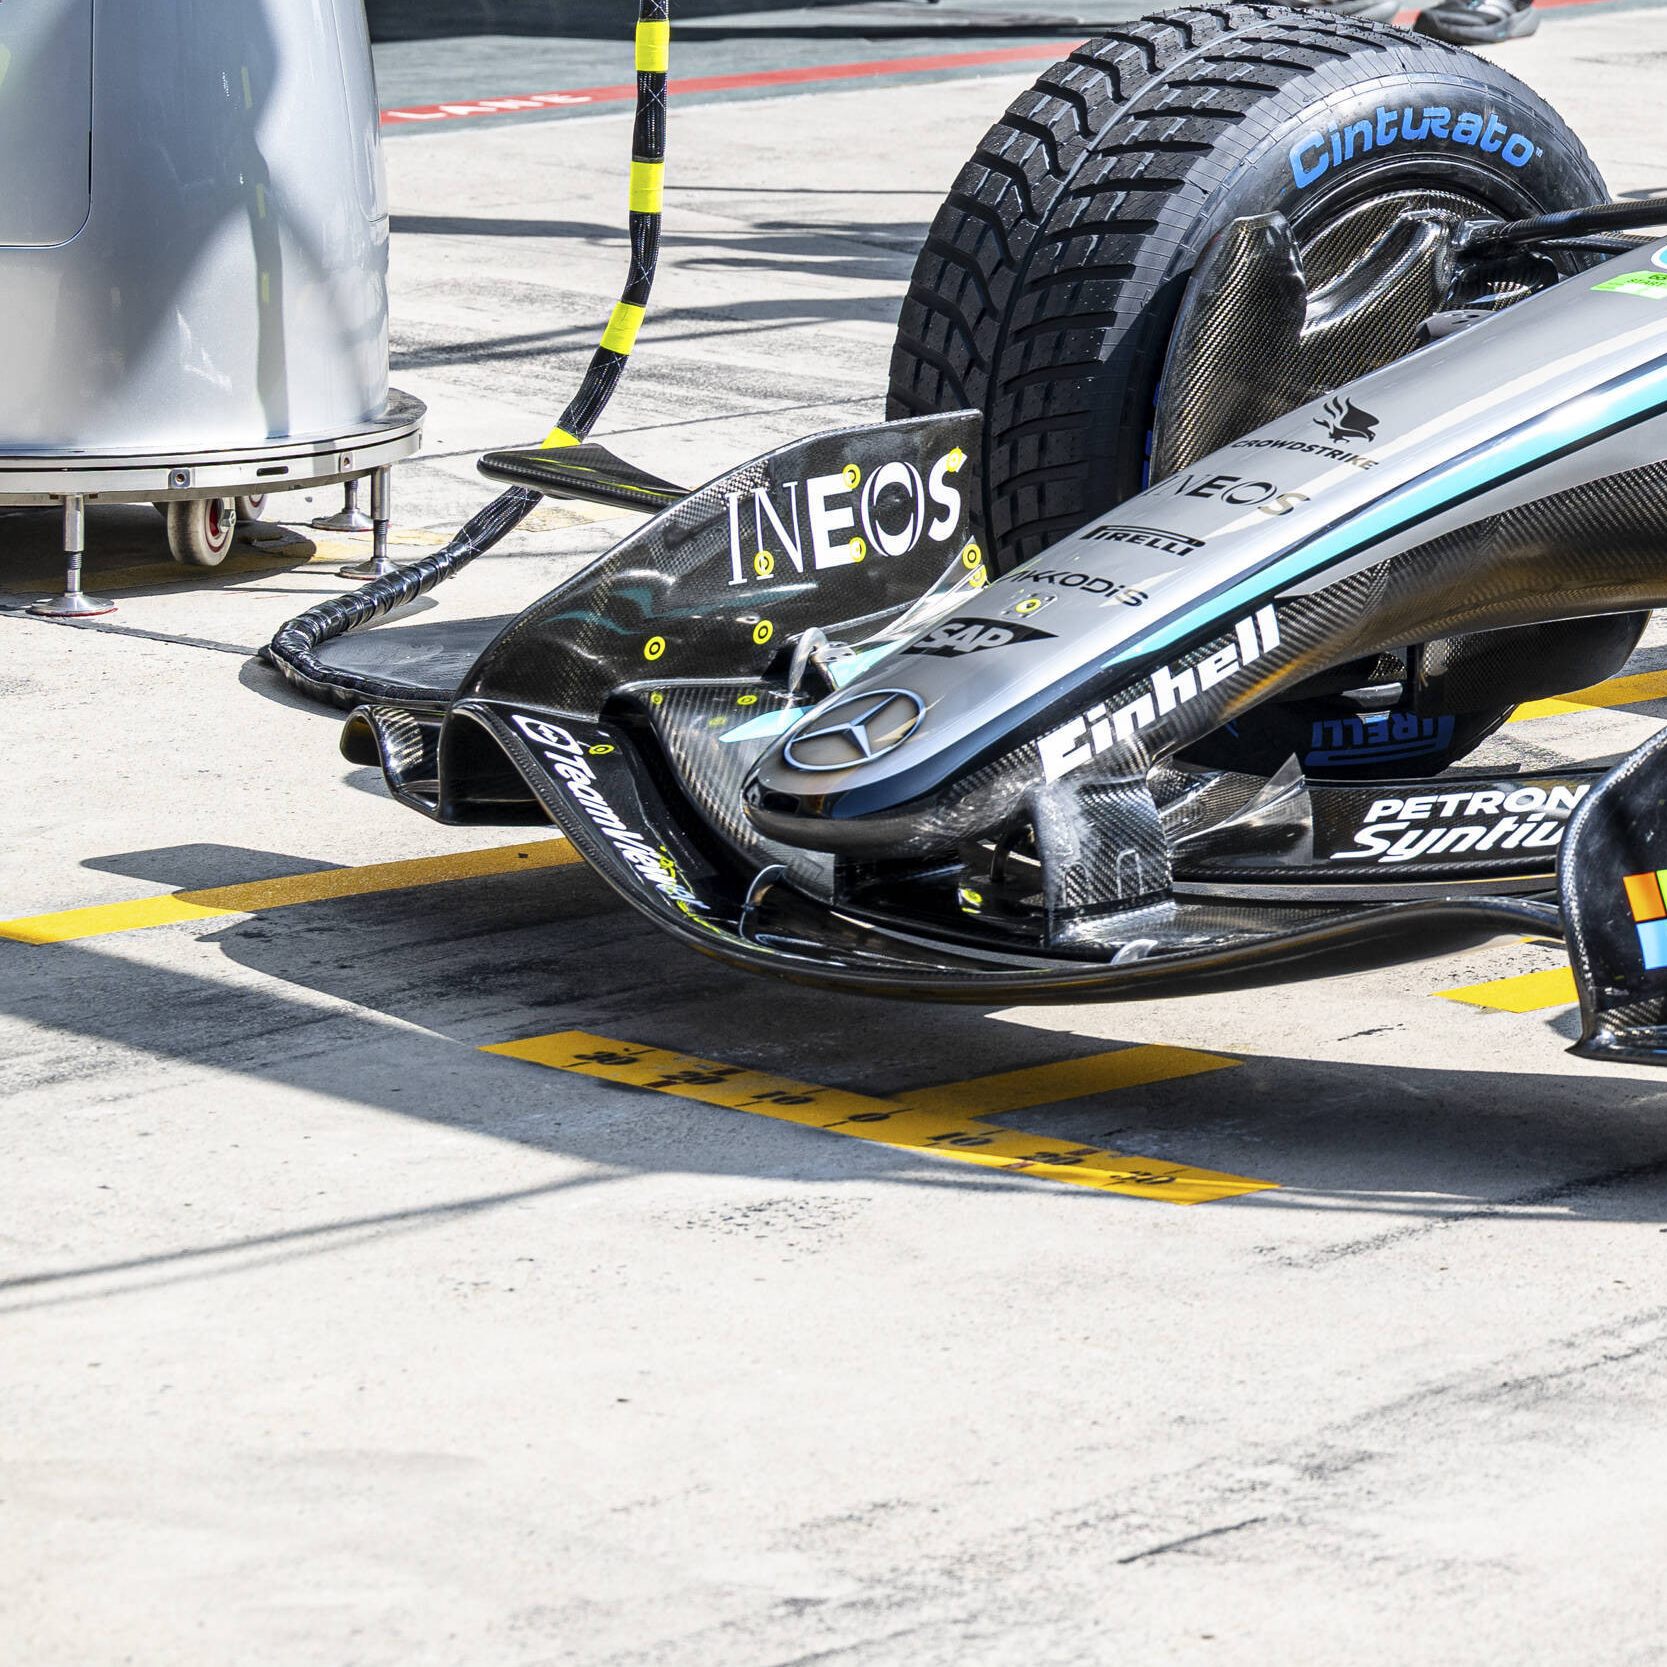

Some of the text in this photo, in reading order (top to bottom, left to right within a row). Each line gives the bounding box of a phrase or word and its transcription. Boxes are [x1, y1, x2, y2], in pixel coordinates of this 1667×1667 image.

[1232, 438, 1380, 471] CROWDSTRIKE
[1144, 473, 1311, 517] INEOS
[727, 449, 967, 586] INEOS
[1079, 524, 1206, 556] PIRELLI
[922, 622, 1014, 653] SAP
[1036, 602, 1282, 786] Einhell
[1364, 783, 1592, 824] PETRON
[1330, 811, 1567, 863] Syntiu
[750, 1090, 817, 1105] 10
[848, 1111, 891, 1122] 0
